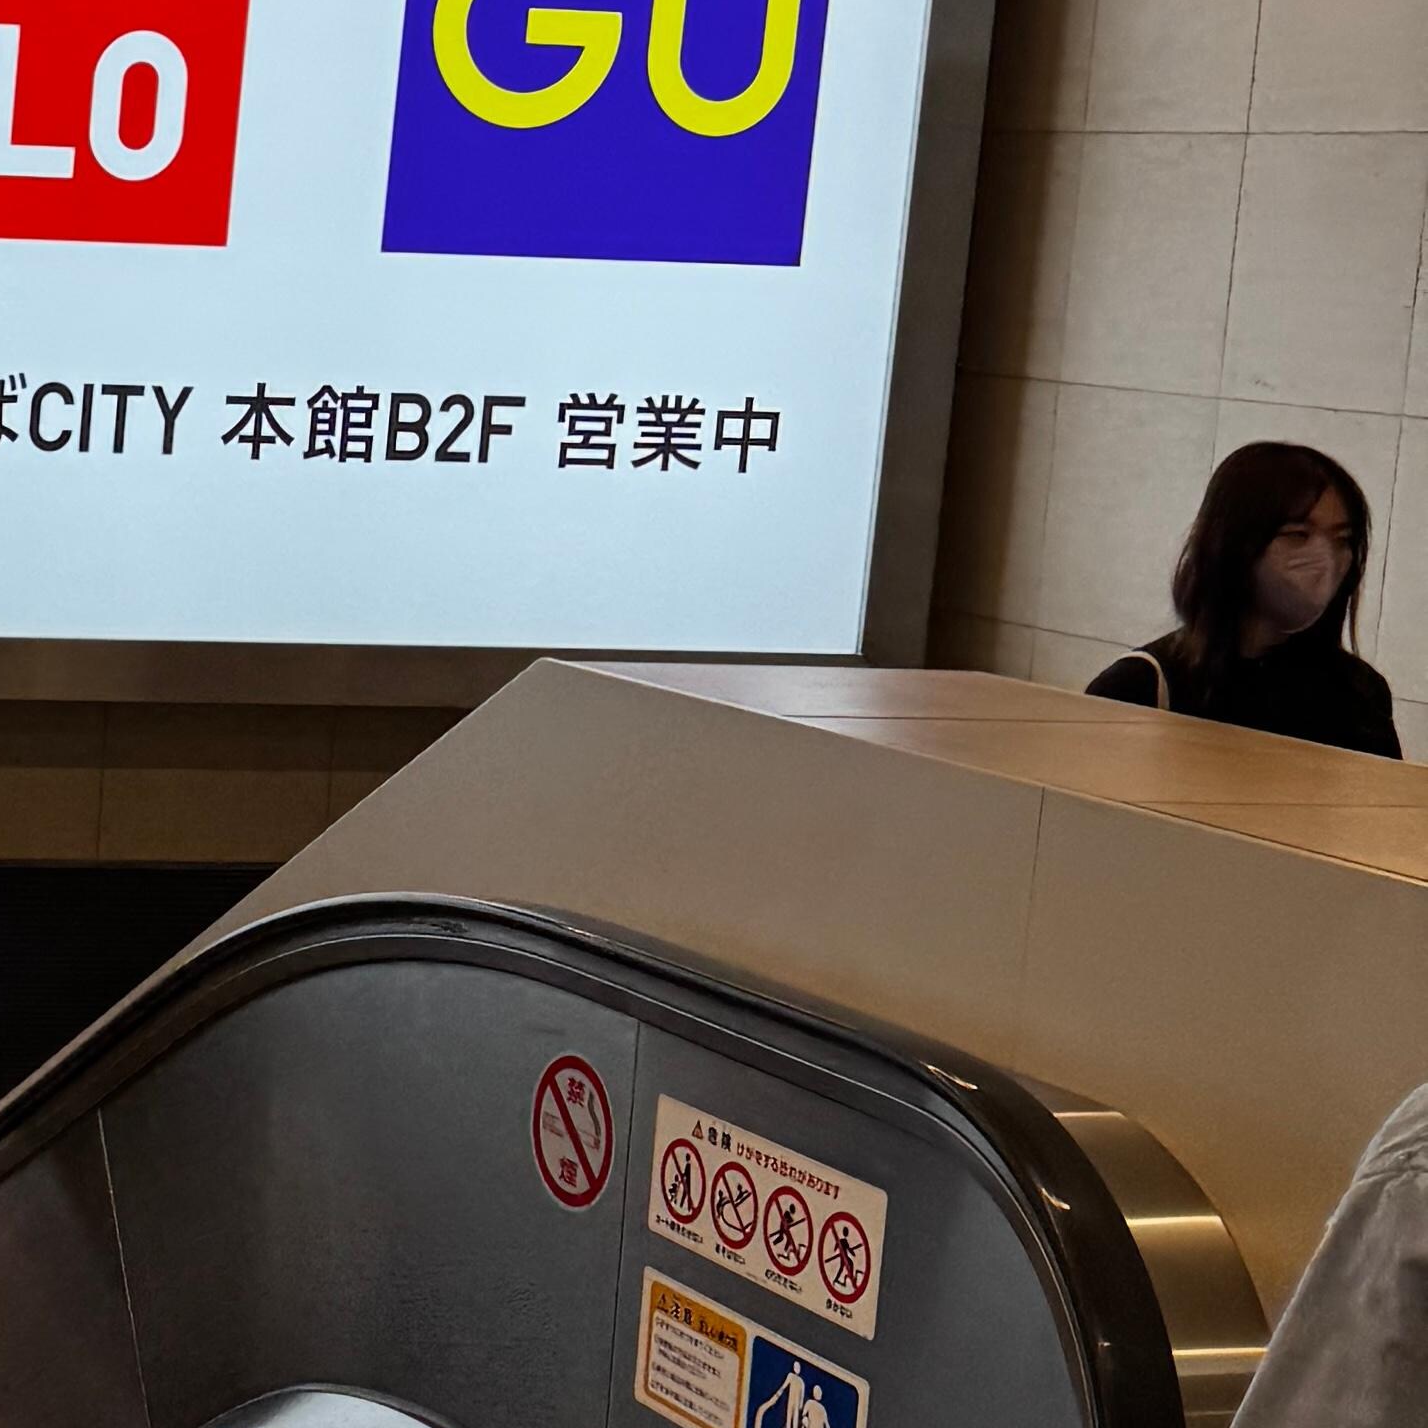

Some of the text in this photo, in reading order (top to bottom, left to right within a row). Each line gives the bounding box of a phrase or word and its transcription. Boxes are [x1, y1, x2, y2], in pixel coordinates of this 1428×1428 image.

[220, 381, 528, 464] 本館B2F
[556, 391, 781, 475] 営業中
